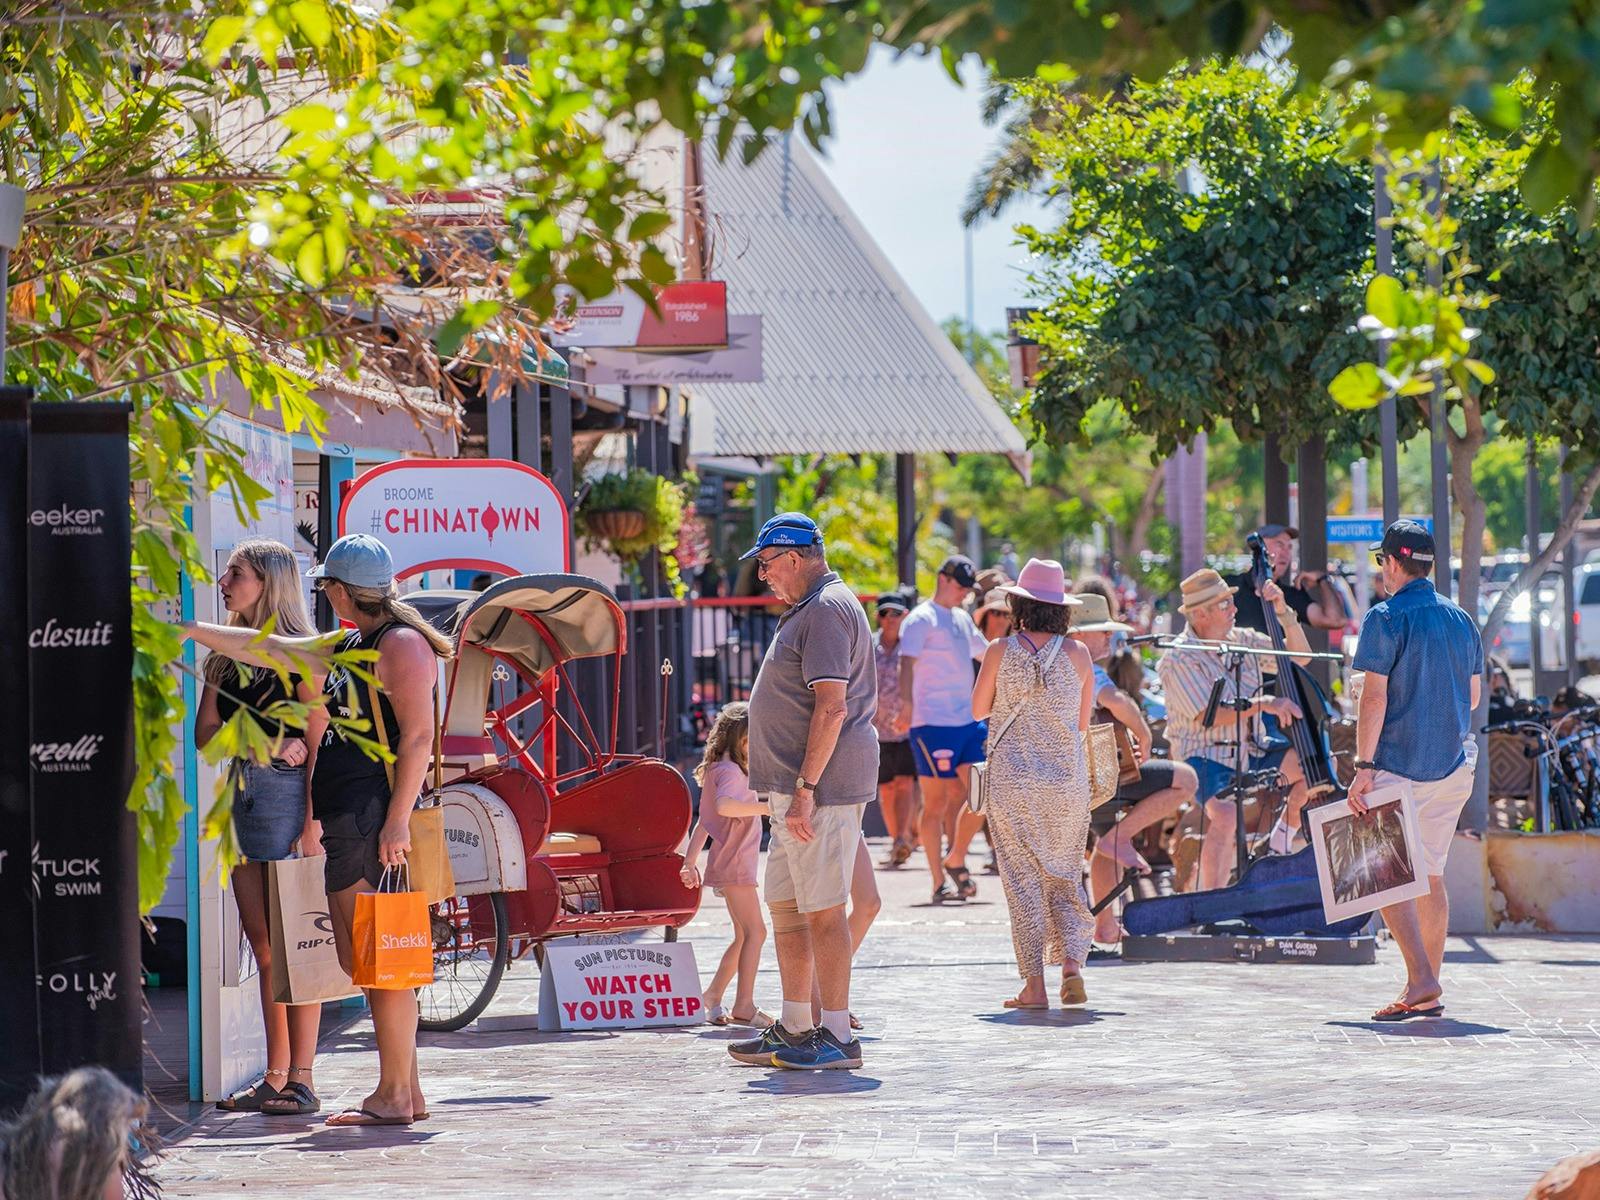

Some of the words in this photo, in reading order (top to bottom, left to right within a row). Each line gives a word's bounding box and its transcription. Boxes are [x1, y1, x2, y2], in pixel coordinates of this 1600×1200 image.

[384, 487, 434, 501] BROOME
[27, 503, 105, 526] eeker
[51, 526, 103, 536] AUSTRALIA
[41, 763, 91, 773] AUSTRALIA
[37, 858, 100, 877] TUCK
[55, 882, 101, 896] SWIM
[297, 939, 324, 950] RIP
[381, 932, 428, 949] Shekki
[1279, 941, 1293, 949] DAN
[574, 951, 603, 971] SUN
[604, 948, 672, 968] PICTURES
[584, 973, 673, 996] WATCH
[86, 981, 117, 1011] girl
[562, 999, 636, 1022] YOUR
[643, 996, 701, 1019] STEP
